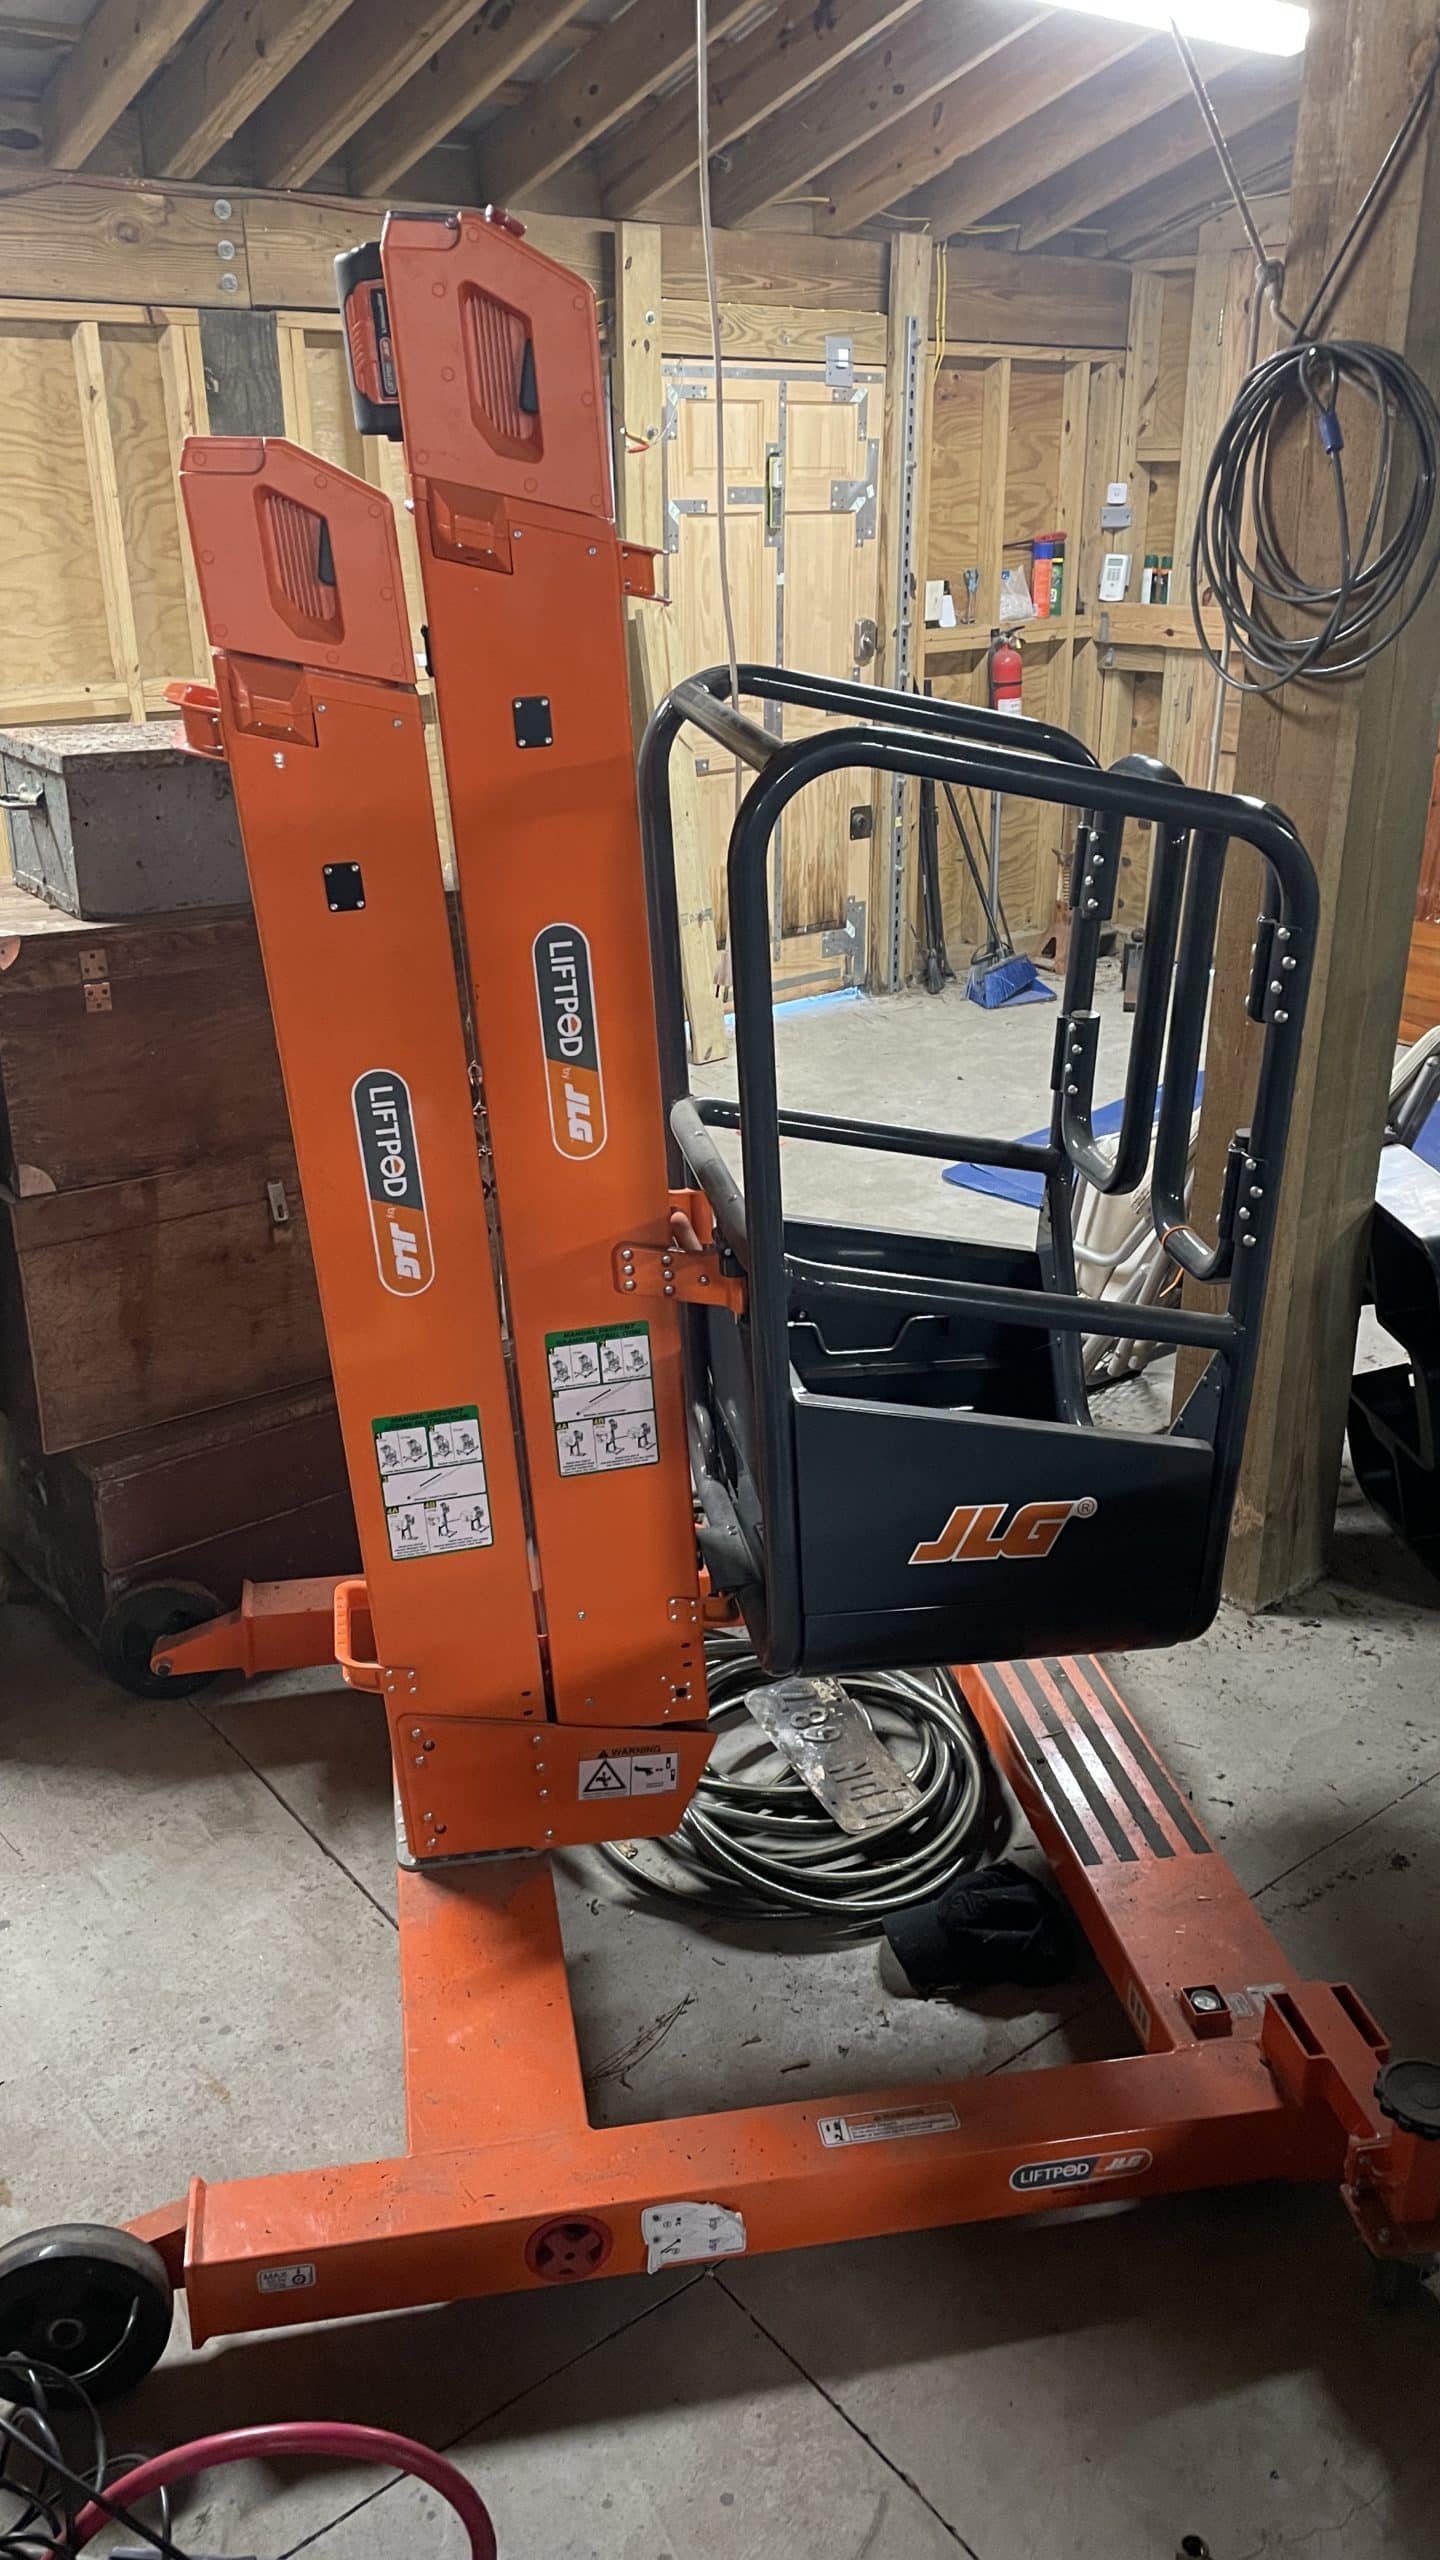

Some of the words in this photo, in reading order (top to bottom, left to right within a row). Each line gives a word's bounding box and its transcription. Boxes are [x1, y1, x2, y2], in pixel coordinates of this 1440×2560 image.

[548, 940, 584, 1058] LIFTPOD
[564, 1082, 593, 1144] JLG
[368, 1085, 408, 1197] LIFTPOD
[389, 1222, 422, 1280] JLG
[1020, 2163, 1090, 2184] LIFTPOD
[1104, 2154, 1145, 2171] JLG
